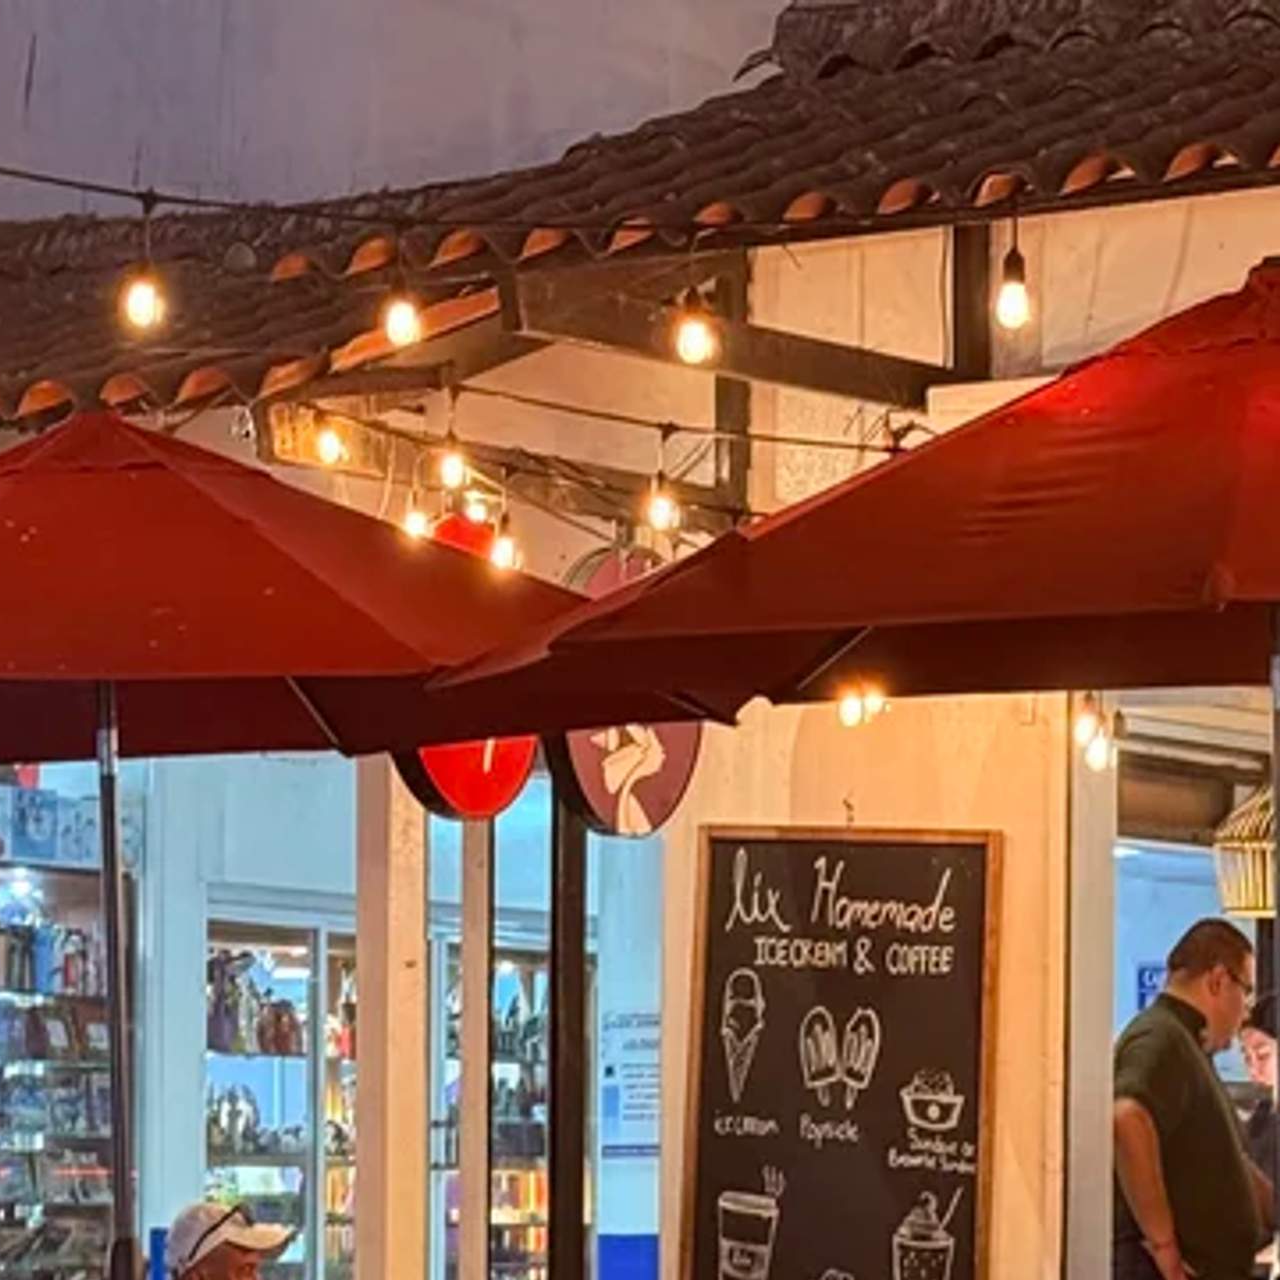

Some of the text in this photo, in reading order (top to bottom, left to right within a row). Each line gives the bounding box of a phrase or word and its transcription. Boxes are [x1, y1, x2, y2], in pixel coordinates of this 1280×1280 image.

[811, 856, 956, 932] Homemade
[853, 938, 875, 974] &
[885, 945, 954, 975] COFFEE
